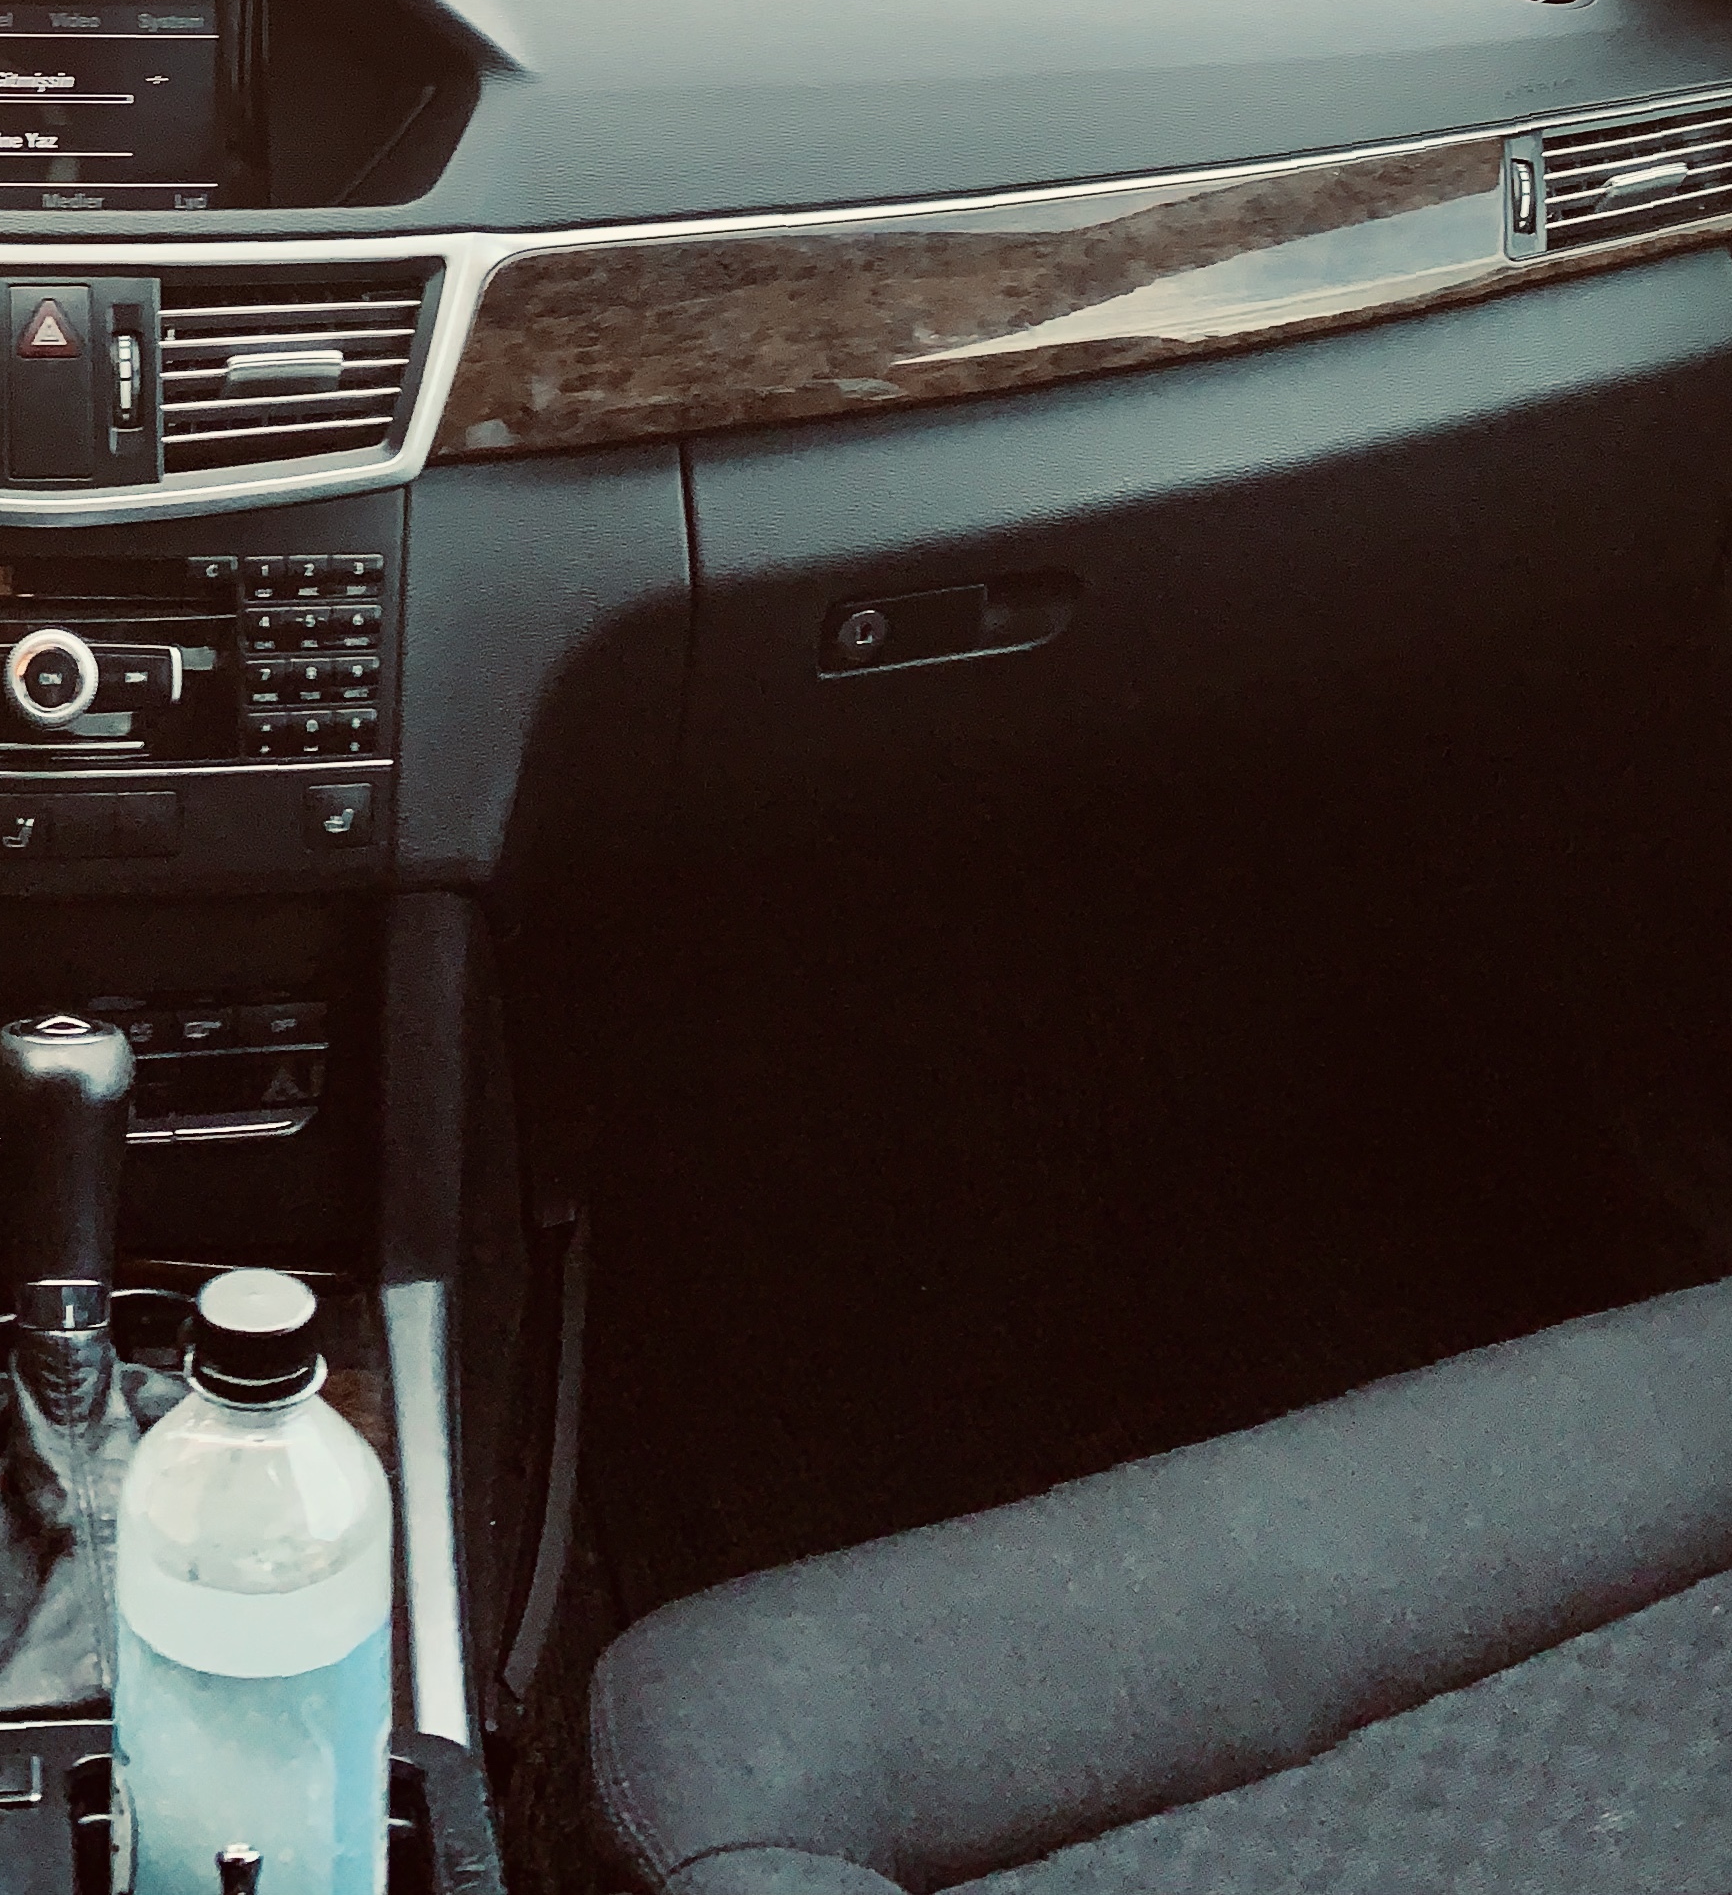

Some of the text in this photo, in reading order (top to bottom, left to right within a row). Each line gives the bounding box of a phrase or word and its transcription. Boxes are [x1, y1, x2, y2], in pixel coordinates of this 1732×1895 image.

[49, 13, 102, 28] Video
[138, 13, 205, 32] System
[24, 132, 59, 149] Yaz
[42, 193, 106, 209] Medier
[174, 193, 208, 210] Lyd
[261, 564, 270, 577] 1
[303, 563, 315, 577] 2
[353, 561, 365, 575] 3
[258, 616, 271, 628] 4
[352, 613, 364, 626] 6
[259, 668, 271, 681] 7
[305, 666, 318, 680] 8
[351, 664, 364, 678] 9
